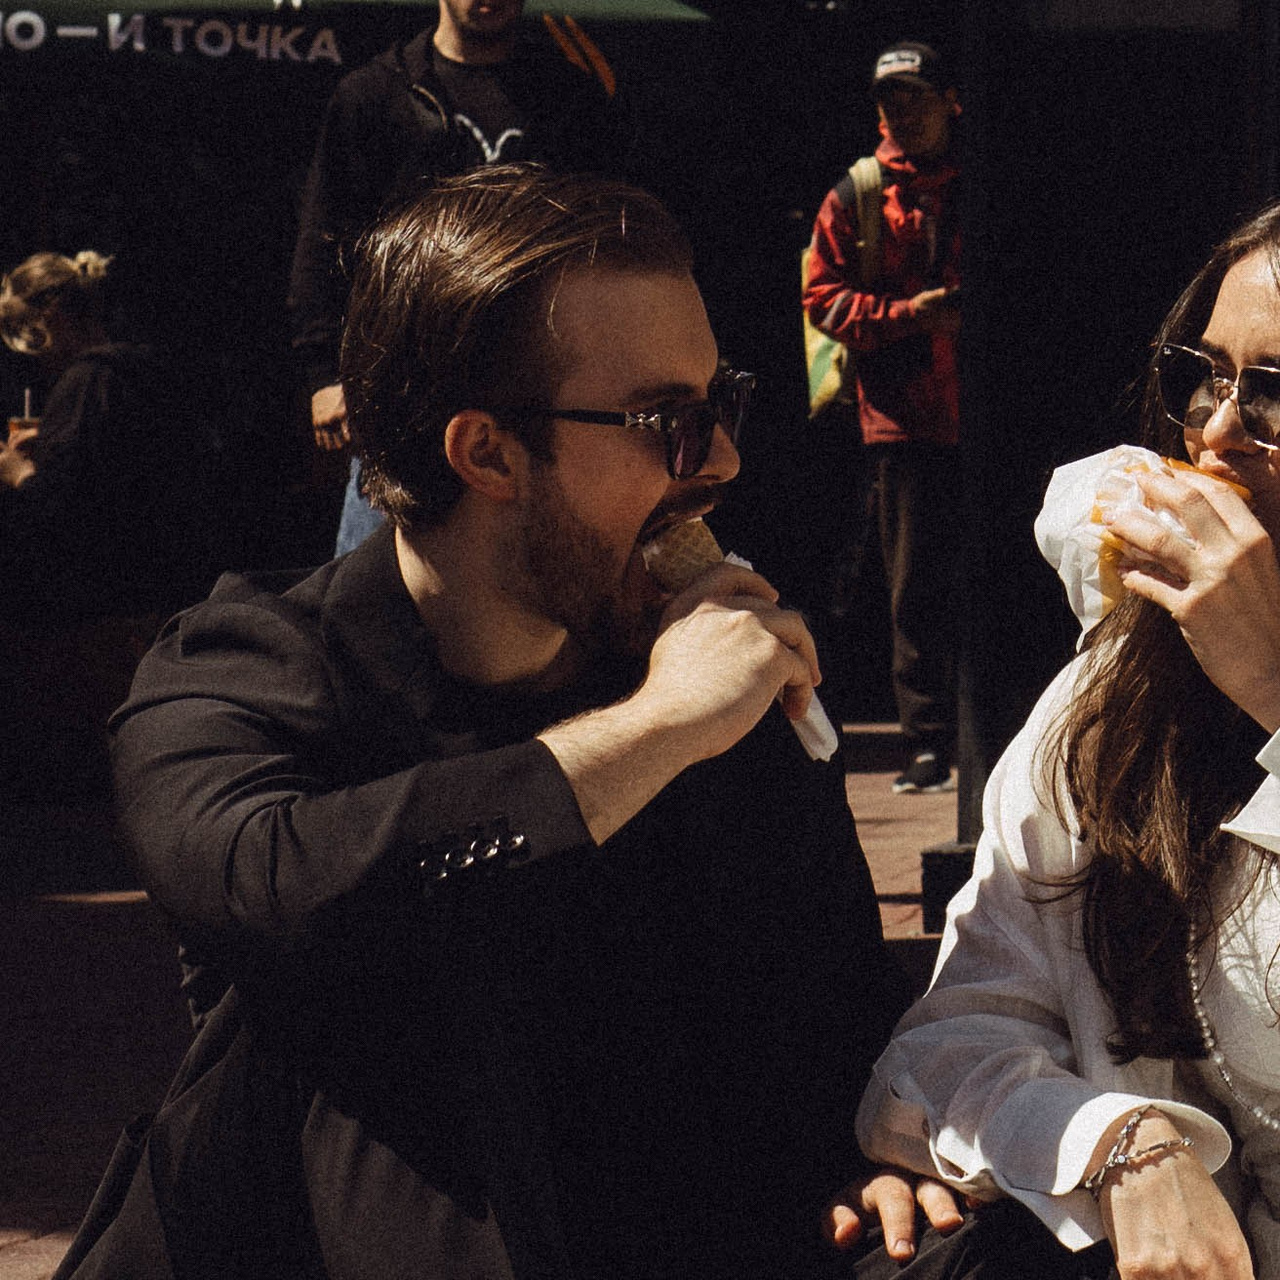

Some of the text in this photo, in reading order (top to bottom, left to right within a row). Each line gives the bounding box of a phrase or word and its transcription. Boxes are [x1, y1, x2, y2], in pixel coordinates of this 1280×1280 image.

[0, 10, 46, 52] О
[107, 13, 146, 52] И
[163, 17, 343, 65] ТОЧКА
